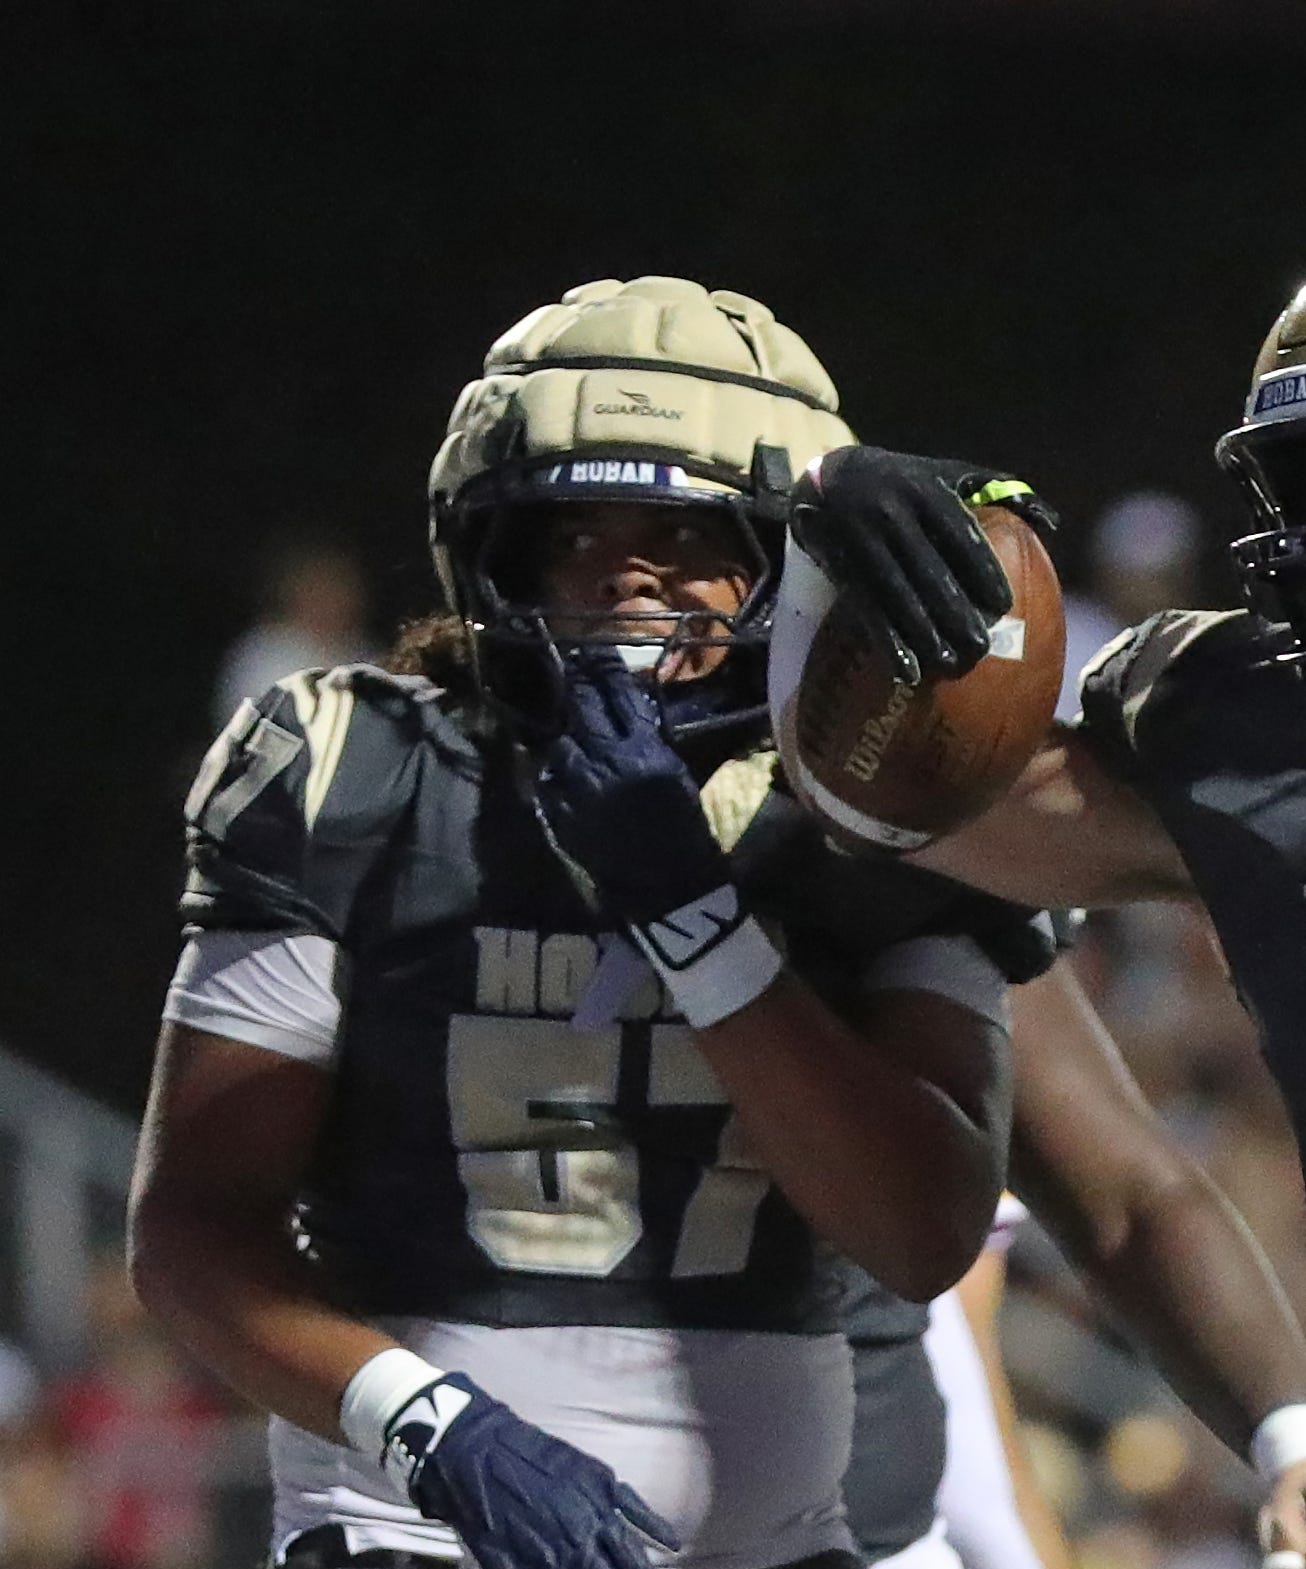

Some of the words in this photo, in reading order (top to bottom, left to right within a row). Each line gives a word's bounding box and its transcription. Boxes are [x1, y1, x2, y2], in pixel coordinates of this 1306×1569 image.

[593, 403, 684, 420] GUARDIAN
[570, 460, 655, 483] HOBAN
[447, 1012, 770, 1280] 57
